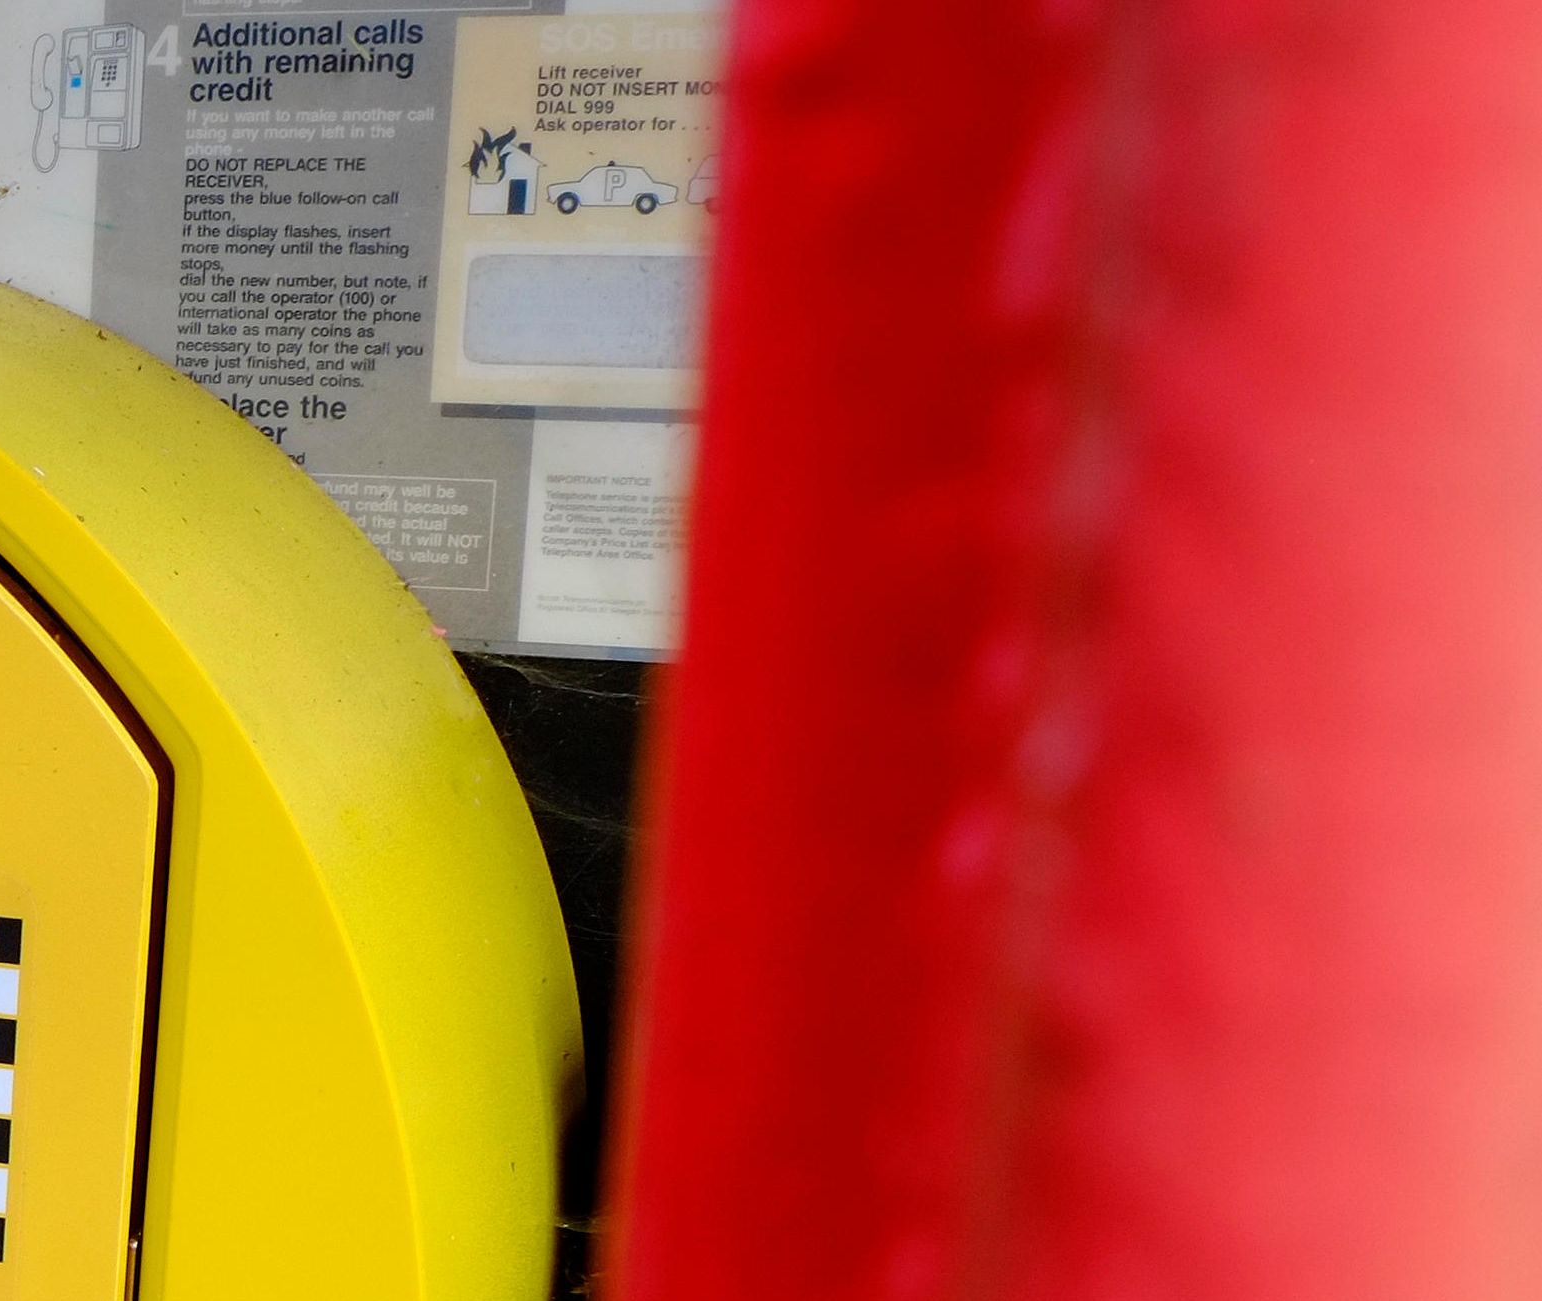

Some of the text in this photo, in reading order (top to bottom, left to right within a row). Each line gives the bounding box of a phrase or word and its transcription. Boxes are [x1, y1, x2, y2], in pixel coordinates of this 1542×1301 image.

[193, 19, 424, 48] Additional calls
[540, 23, 614, 50] SOS
[147, 24, 181, 76] 4
[192, 48, 414, 79] with remaining
[538, 65, 642, 80] Lift receiver
[190, 77, 273, 102] credit
[537, 83, 563, 98] DO
[569, 82, 606, 97] NOT
[612, 81, 678, 96] INSERT
[202, 113, 229, 126] you
[235, 109, 269, 122] want
[276, 109, 291, 122] to
[296, 108, 337, 122] make
[342, 107, 403, 122] another
[407, 106, 435, 121] call
[536, 100, 614, 115] DIAL 999
[186, 124, 396, 142] using any money left in the
[534, 117, 676, 134] Ask operator for
[186, 158, 366, 171] DO NOT REPLACE THE
[185, 175, 268, 189] RECEIVER,
[604, 168, 626, 201] P
[185, 192, 399, 207] press the blue follow-on call
[183, 209, 235, 222] button,
[182, 225, 391, 241] if the display flashes, insert
[181, 242, 409, 259] more money until the flashing
[181, 258, 224, 272] stops,
[179, 272, 428, 290] dial the new number, but note, if
[179, 290, 396, 307] you call the operator (100) or
[178, 307, 422, 325] international operator the phone
[178, 323, 375, 340] will take as many coins as
[176, 341, 424, 358] necessary to pay for the call you
[175, 355, 376, 372] have just finished, and will
[227, 372, 365, 388] any unused coins.
[300, 394, 347, 420] the
[364, 484, 456, 500] may well be
[355, 500, 398, 513] credit
[404, 502, 469, 516] because
